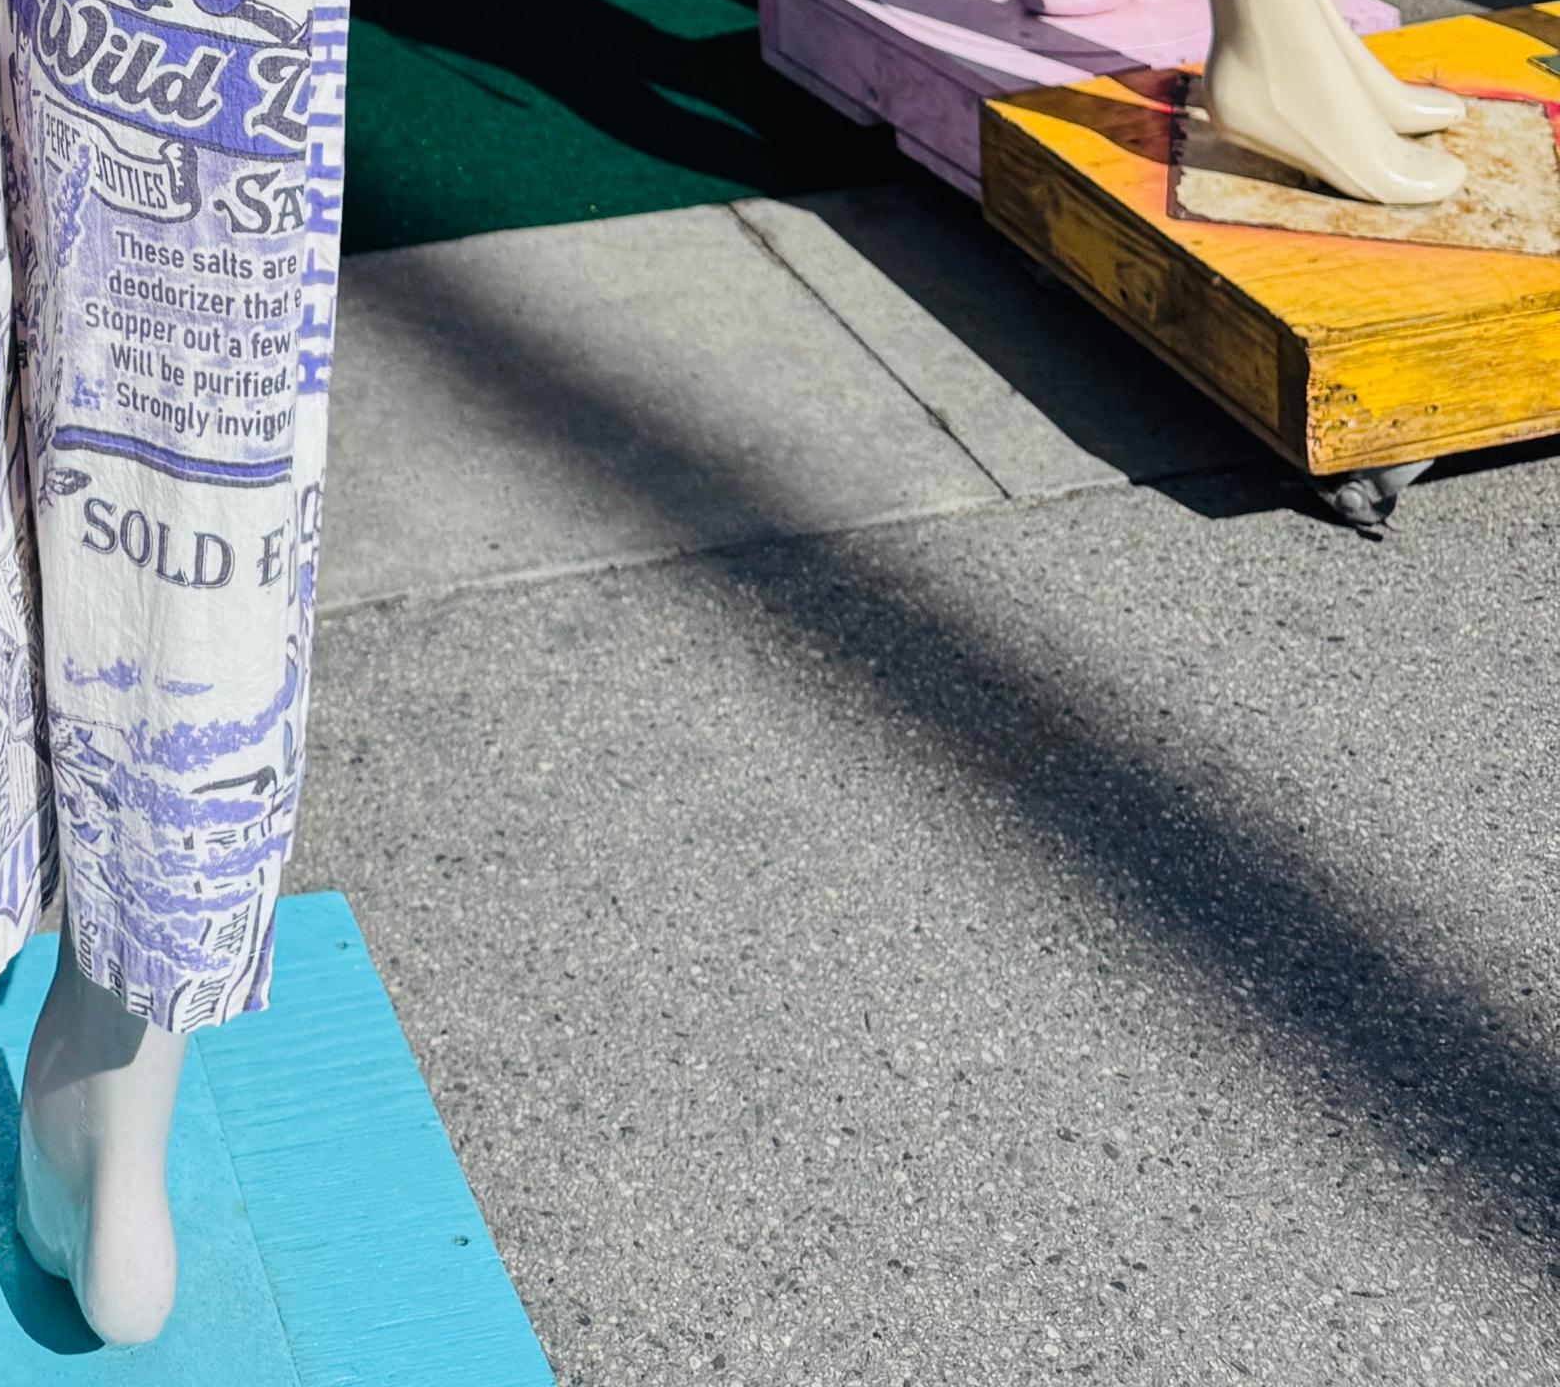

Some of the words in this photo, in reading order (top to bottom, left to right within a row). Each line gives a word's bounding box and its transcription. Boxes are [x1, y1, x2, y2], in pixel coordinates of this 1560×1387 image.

[115, 230, 185, 269] These
[193, 248, 253, 280] salts
[263, 254, 297, 281] are
[109, 269, 235, 317] deodorizer
[244, 293, 289, 321] that
[85, 303, 177, 343] Stopper
[183, 329, 221, 355] out
[228, 338, 242, 359] a
[251, 331, 291, 359] few
[111, 342, 154, 378] Will
[161, 355, 185, 387] be
[116, 382, 210, 434] Strongly
[81, 496, 236, 590] SOLD
